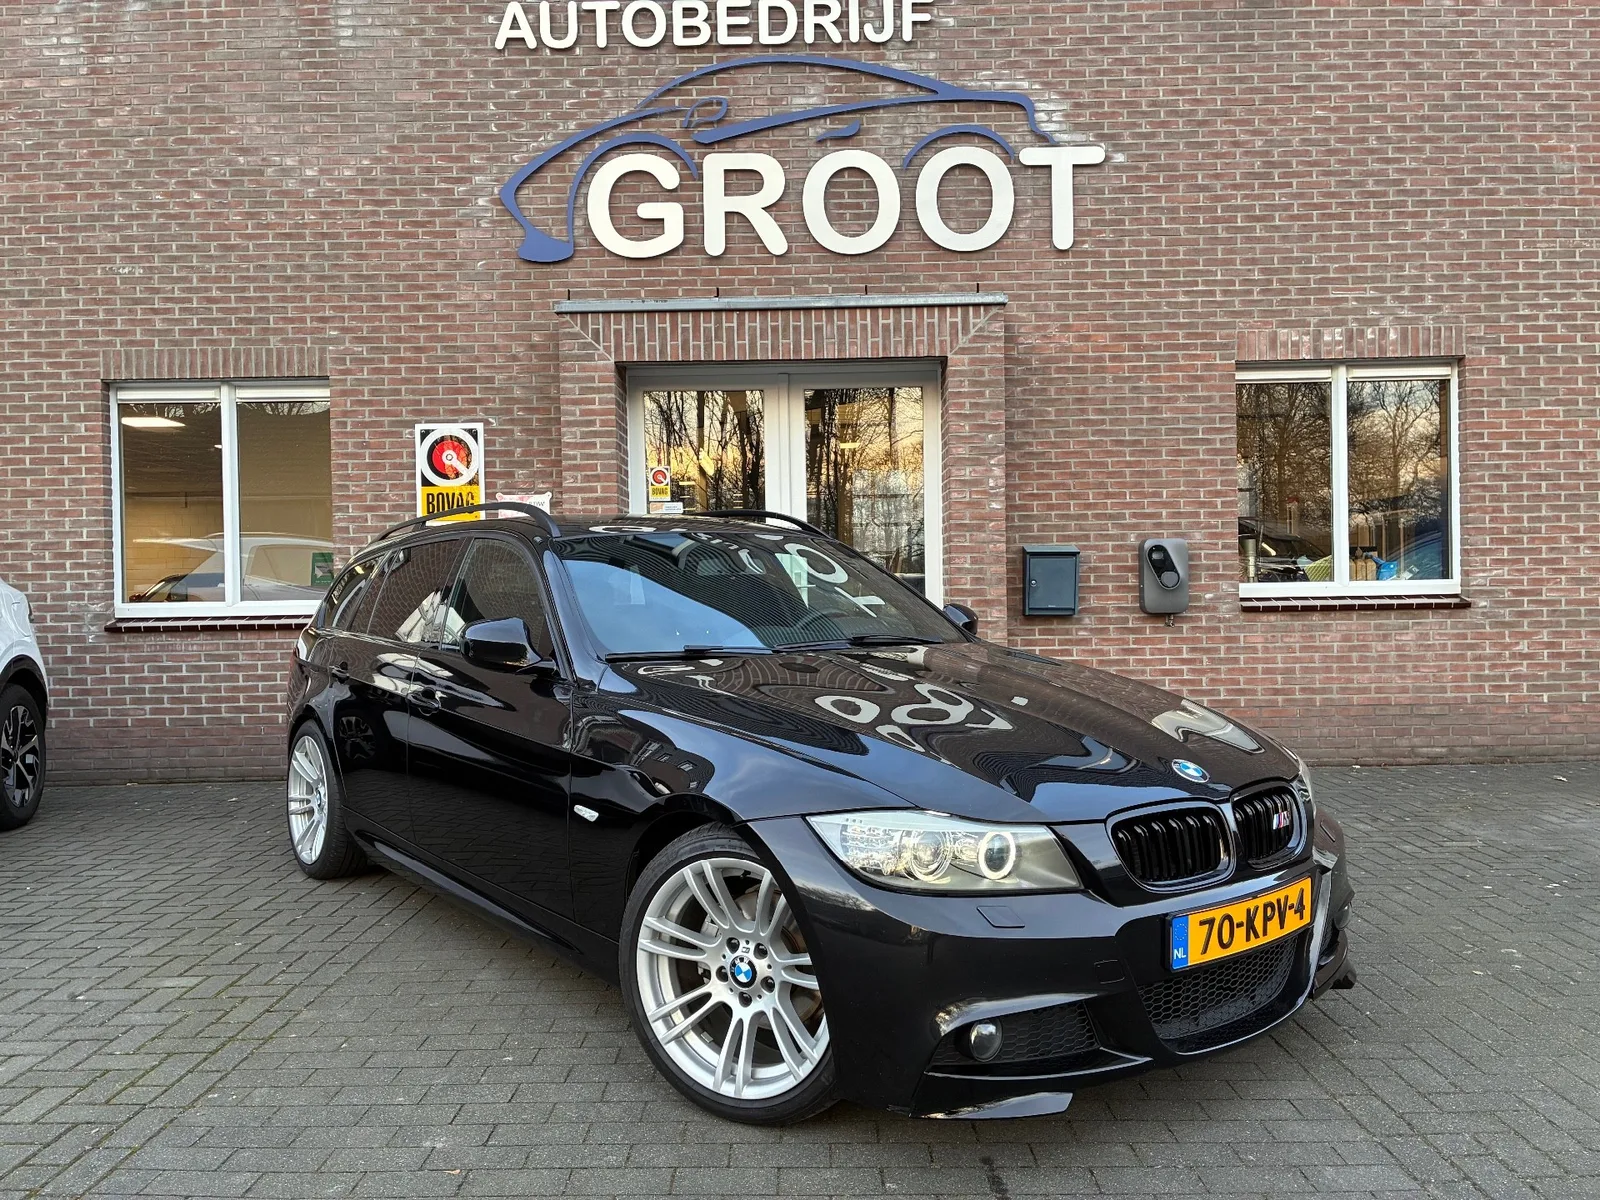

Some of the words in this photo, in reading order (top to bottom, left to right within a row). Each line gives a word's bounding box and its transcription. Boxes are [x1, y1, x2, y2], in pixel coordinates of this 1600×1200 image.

[494, 0, 933, 49] AUTOBEDRIJF
[588, 143, 1105, 258] GROOT
[1198, 888, 1306, 955] 70-KPV-4
[1173, 947, 1187, 960] NL
